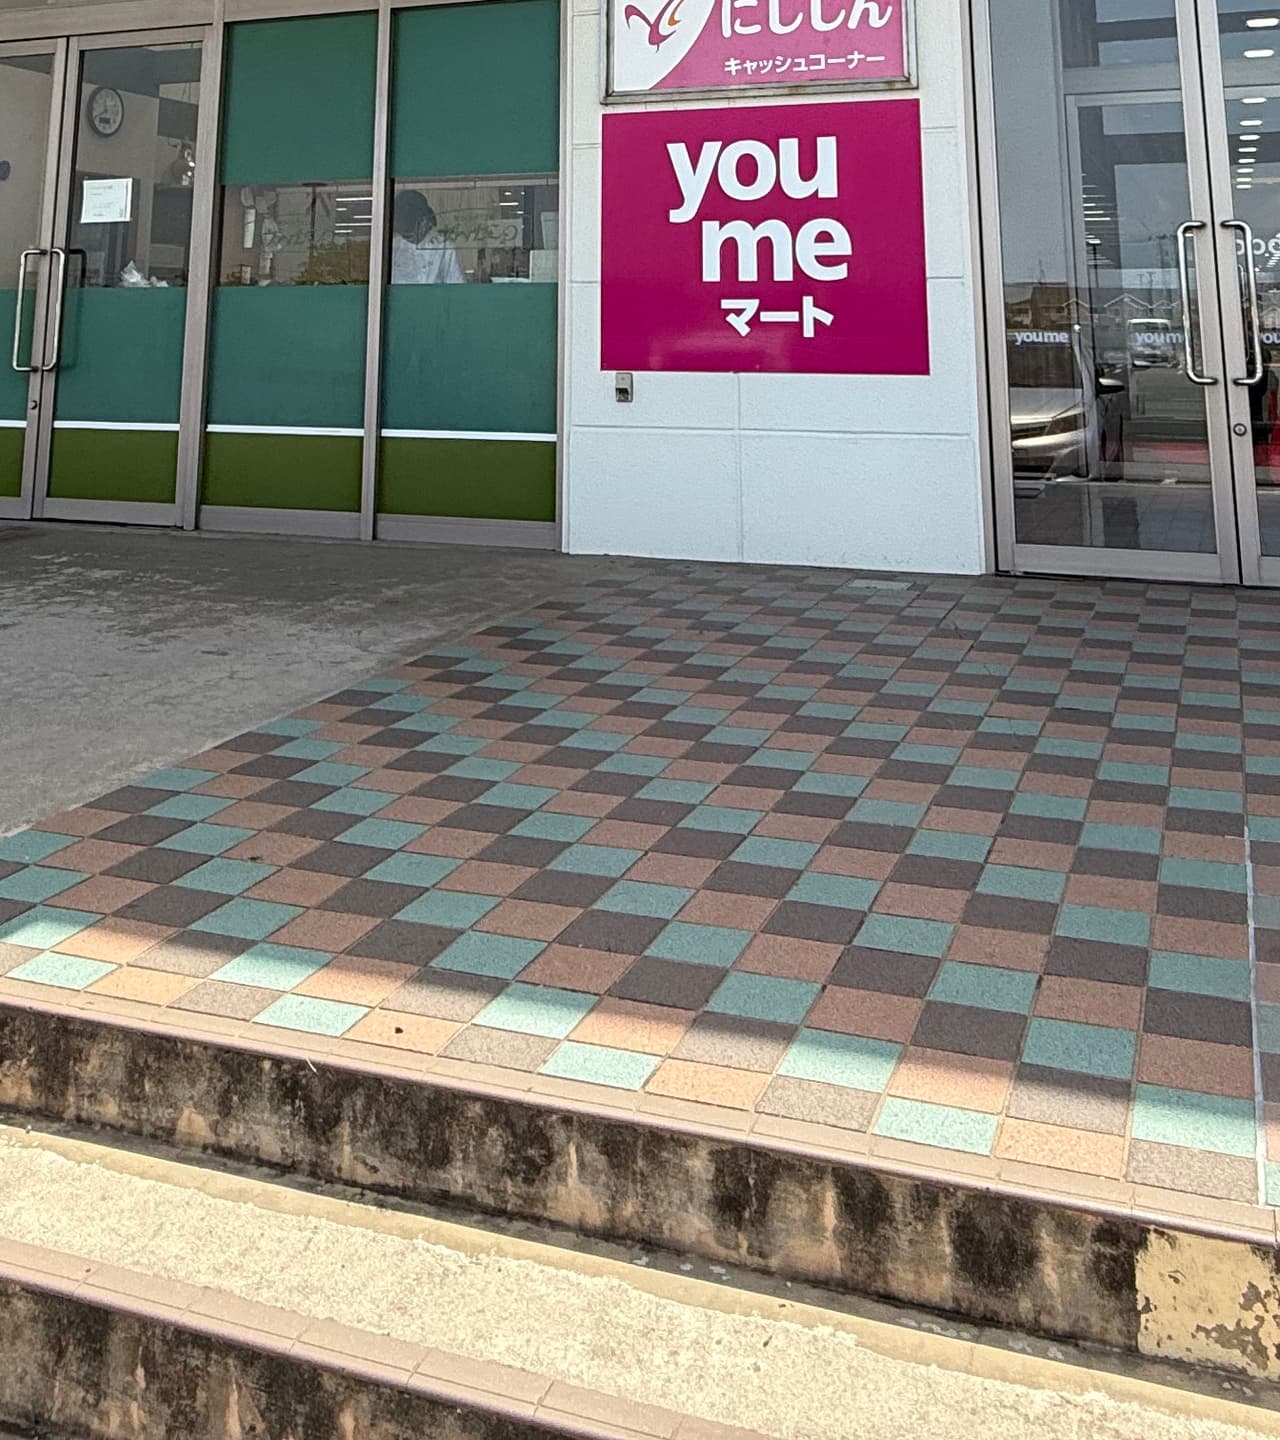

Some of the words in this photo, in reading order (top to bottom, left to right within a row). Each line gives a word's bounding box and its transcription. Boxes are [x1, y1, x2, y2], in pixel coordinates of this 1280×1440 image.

[724, 51, 885, 76] キャッシュコーナー
[666, 136, 838, 223] you
[702, 218, 852, 282] me
[721, 296, 834, 337] マート
[1136, 331, 1183, 344] youm
